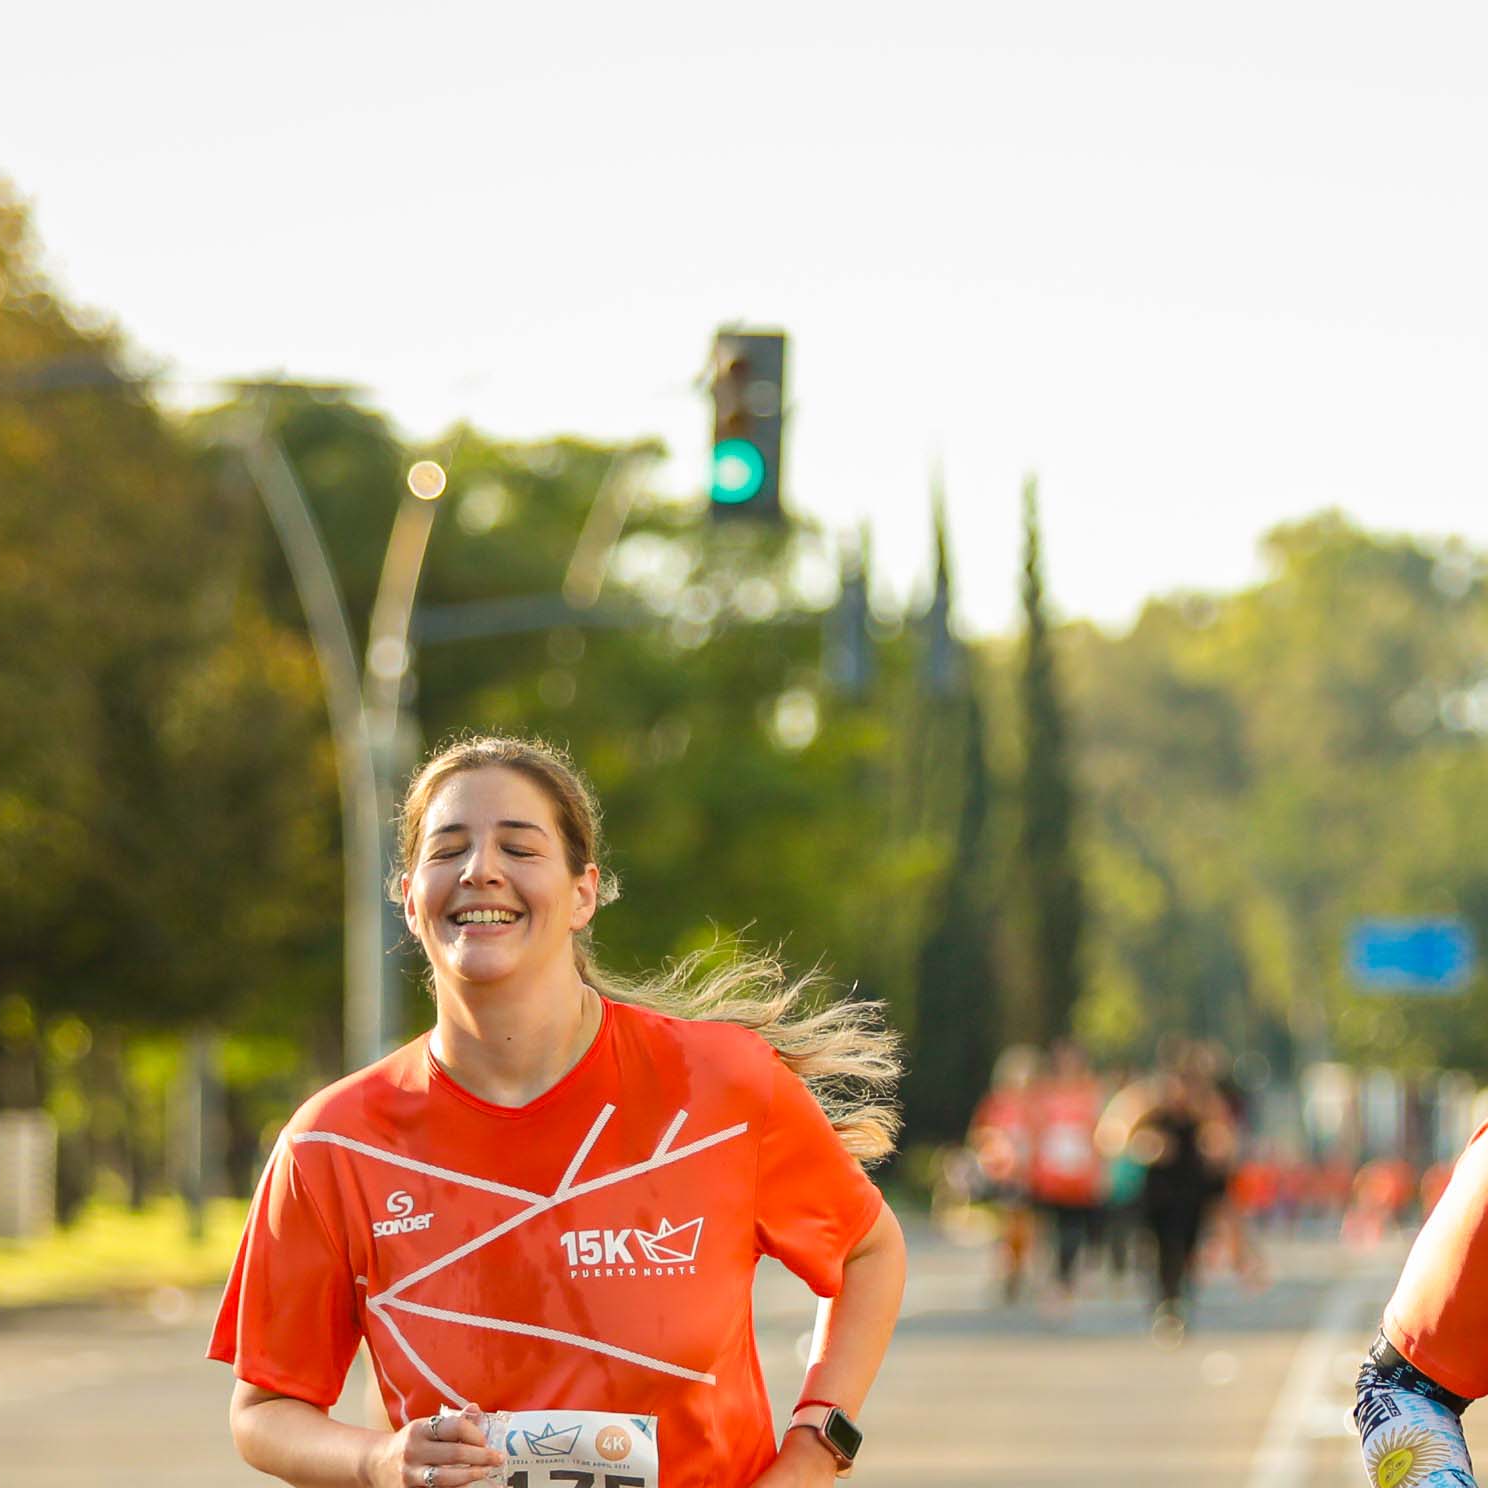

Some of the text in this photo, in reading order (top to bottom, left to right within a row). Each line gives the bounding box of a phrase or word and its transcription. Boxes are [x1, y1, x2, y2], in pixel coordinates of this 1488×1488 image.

[560, 1229, 635, 1266] 15K
[571, 1266, 696, 1279] PUERTO NORTE
[602, 1435, 625, 1451] 4K
